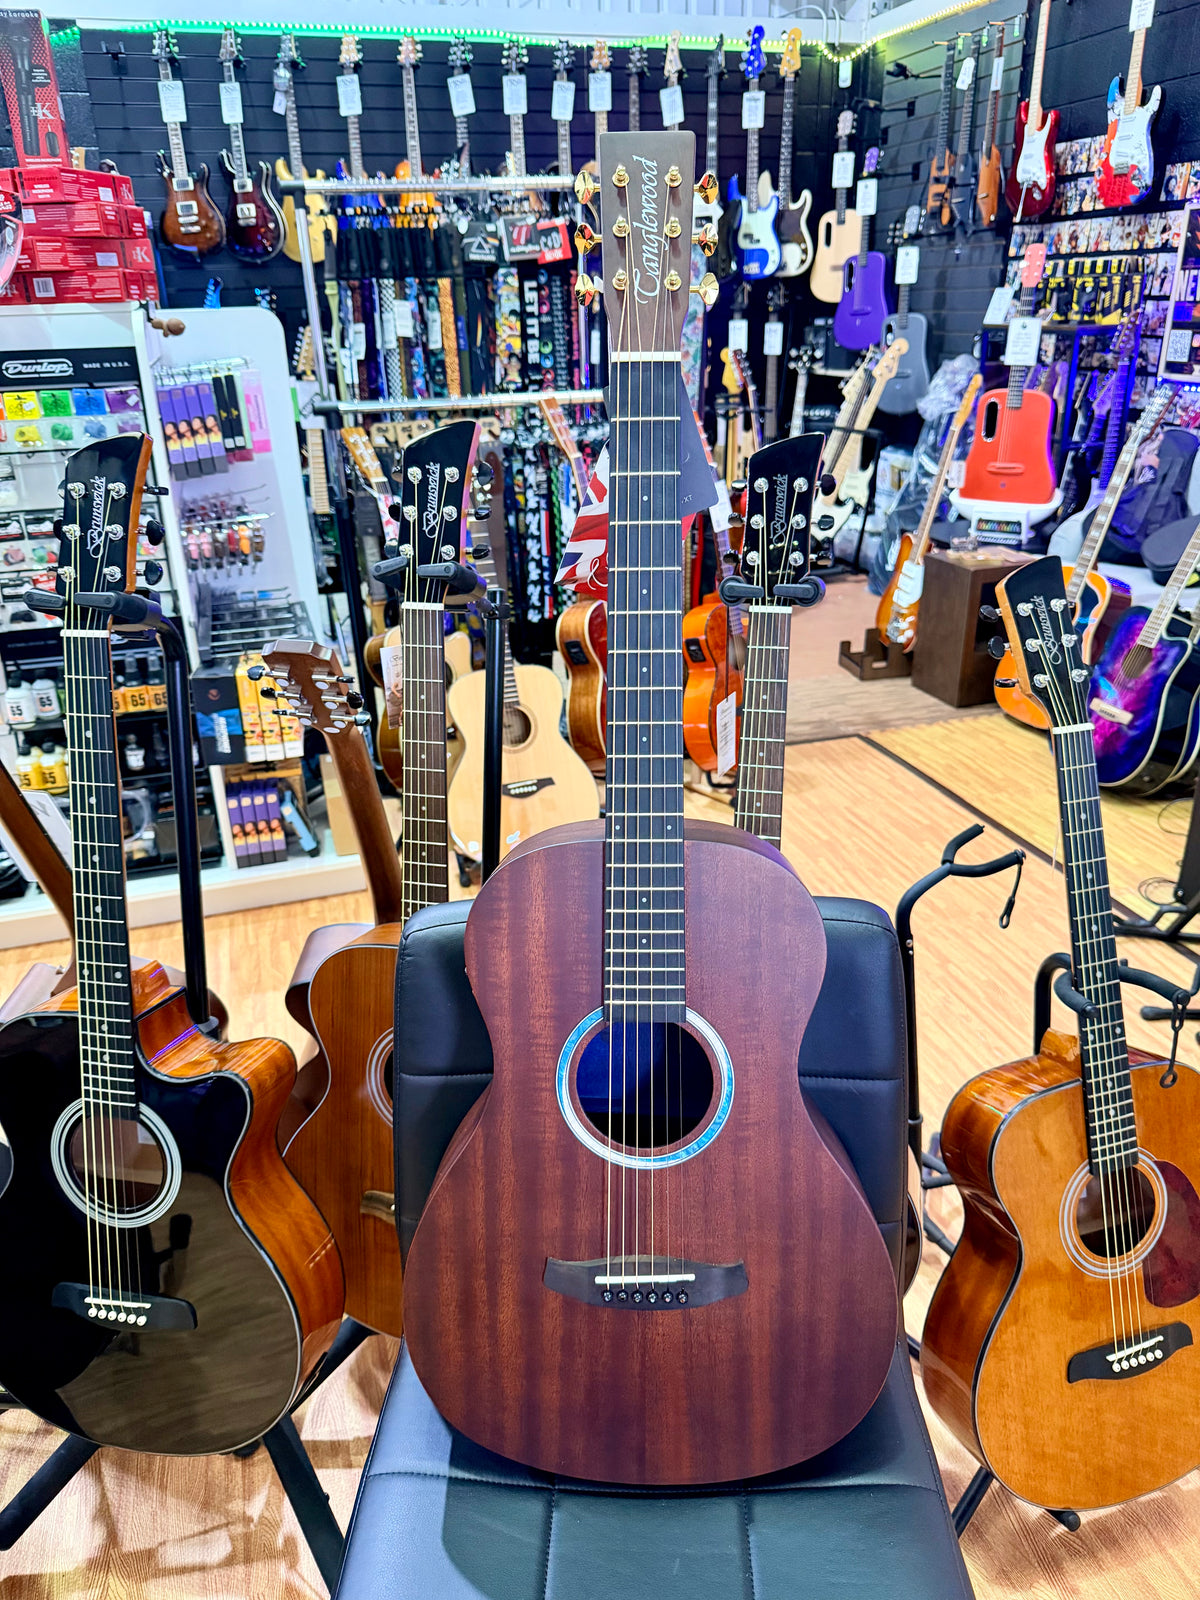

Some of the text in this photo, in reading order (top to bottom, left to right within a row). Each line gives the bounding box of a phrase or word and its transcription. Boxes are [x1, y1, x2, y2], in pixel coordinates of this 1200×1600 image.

[632, 154, 669, 304] Tanglewood
[523, 280, 539, 316] LET
[7, 362, 70, 374] Dunlop
[527, 339, 540, 365] BE
[86, 475, 106, 559] Brunswick
[422, 461, 441, 538] Brunswick
[770, 473, 788, 546] Brunswick
[39, 695, 53, 708] 65
[130, 693, 146, 708] 65
